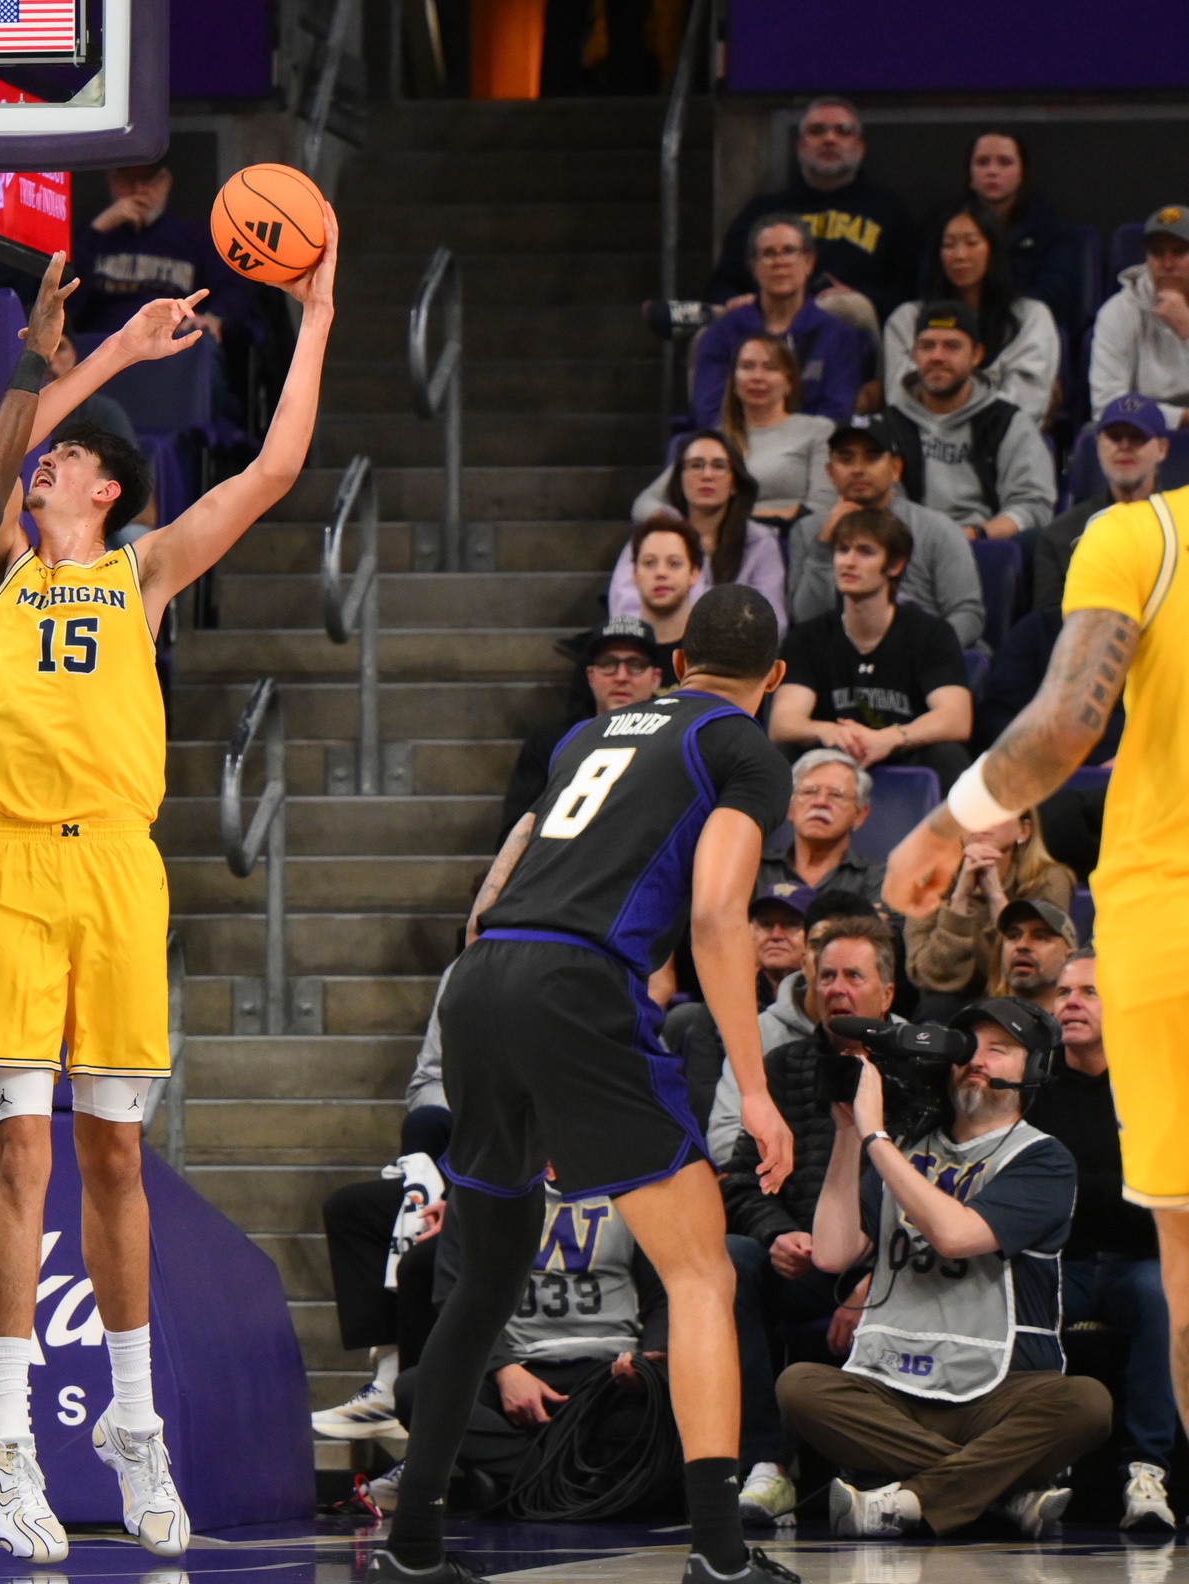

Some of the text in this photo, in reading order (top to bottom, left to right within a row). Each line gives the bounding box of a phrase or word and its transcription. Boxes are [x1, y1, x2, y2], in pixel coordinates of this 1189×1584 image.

[227, 237, 265, 272] W
[38, 616, 99, 675] 15
[540, 747, 637, 839] 8
[61, 824, 80, 837] M
